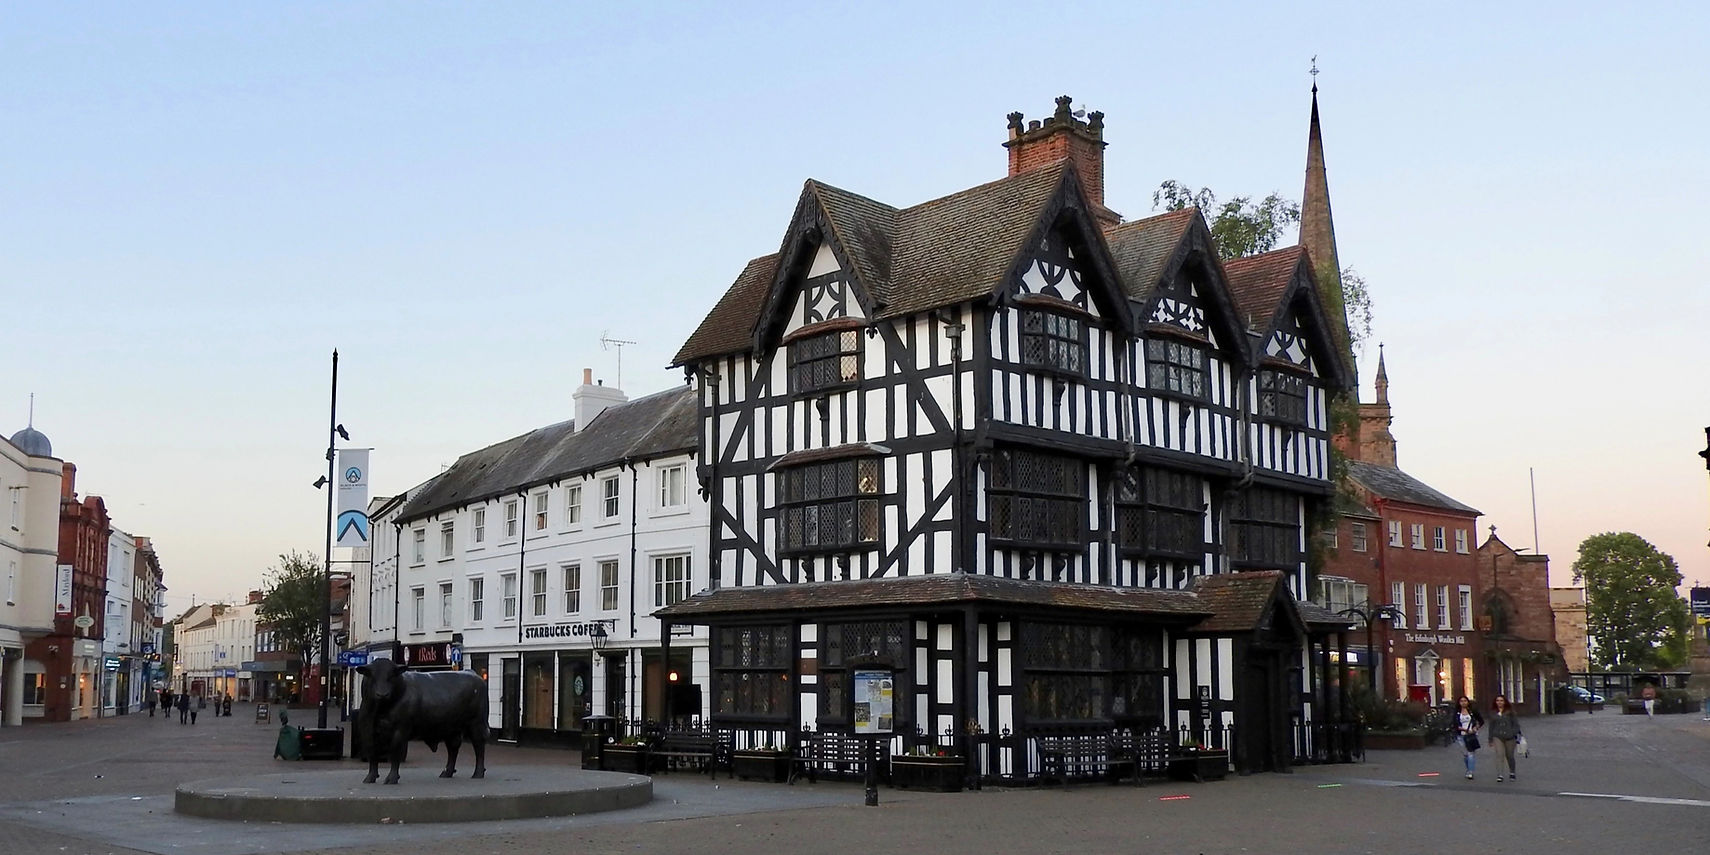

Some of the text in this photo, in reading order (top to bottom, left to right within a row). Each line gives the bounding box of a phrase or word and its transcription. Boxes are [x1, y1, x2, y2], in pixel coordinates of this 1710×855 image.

[525, 623, 605, 639] STARBUCKS COFF
[1405, 633, 1414, 643] The
[1414, 634, 1437, 645] Edinburgh
